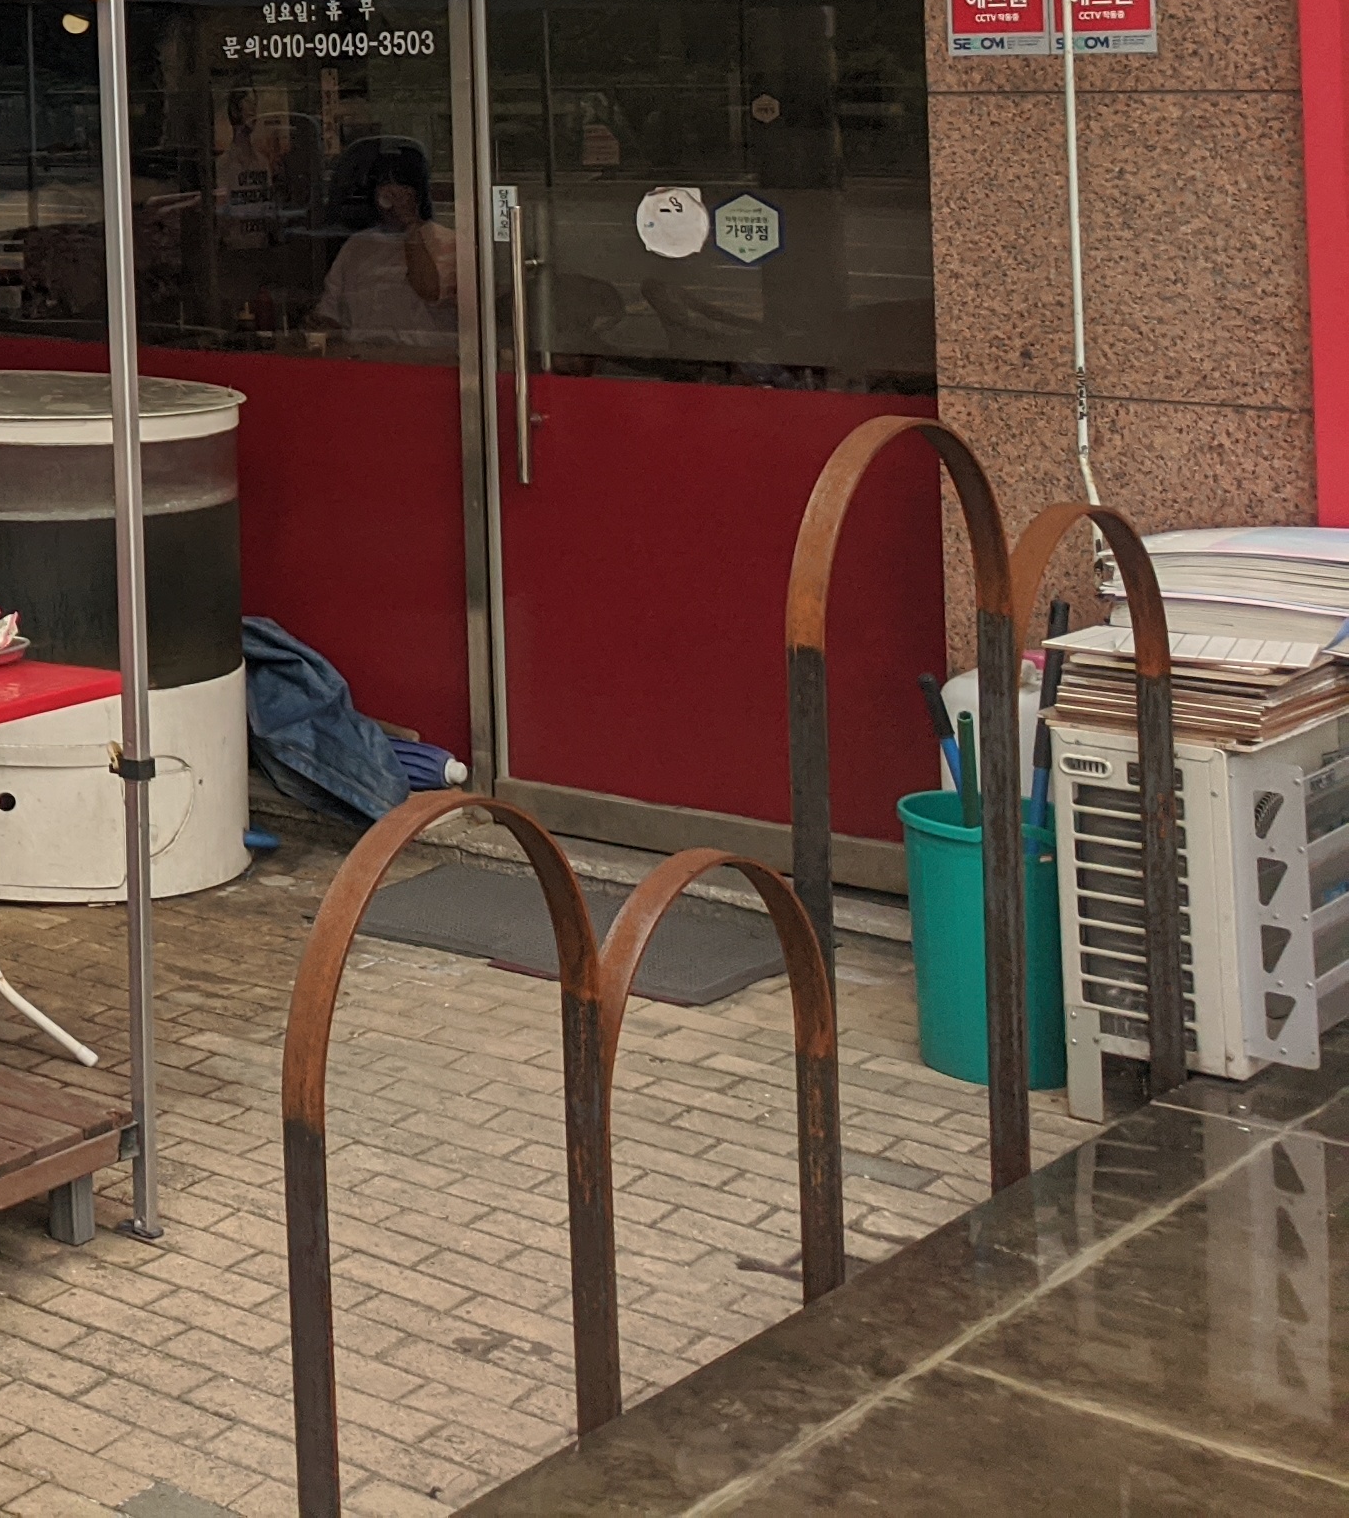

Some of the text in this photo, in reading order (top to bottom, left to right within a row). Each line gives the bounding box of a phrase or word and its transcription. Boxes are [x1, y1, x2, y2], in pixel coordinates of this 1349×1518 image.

[262, 1, 316, 24] 일요일:
[325, 0, 343, 22] 휴
[975, 13, 996, 23] CCTV
[1079, 11, 1102, 20] CCTV
[953, 37, 1005, 50] SECOM
[1056, 36, 1110, 50] SCOM
[725, 224, 769, 241] 가맹점
